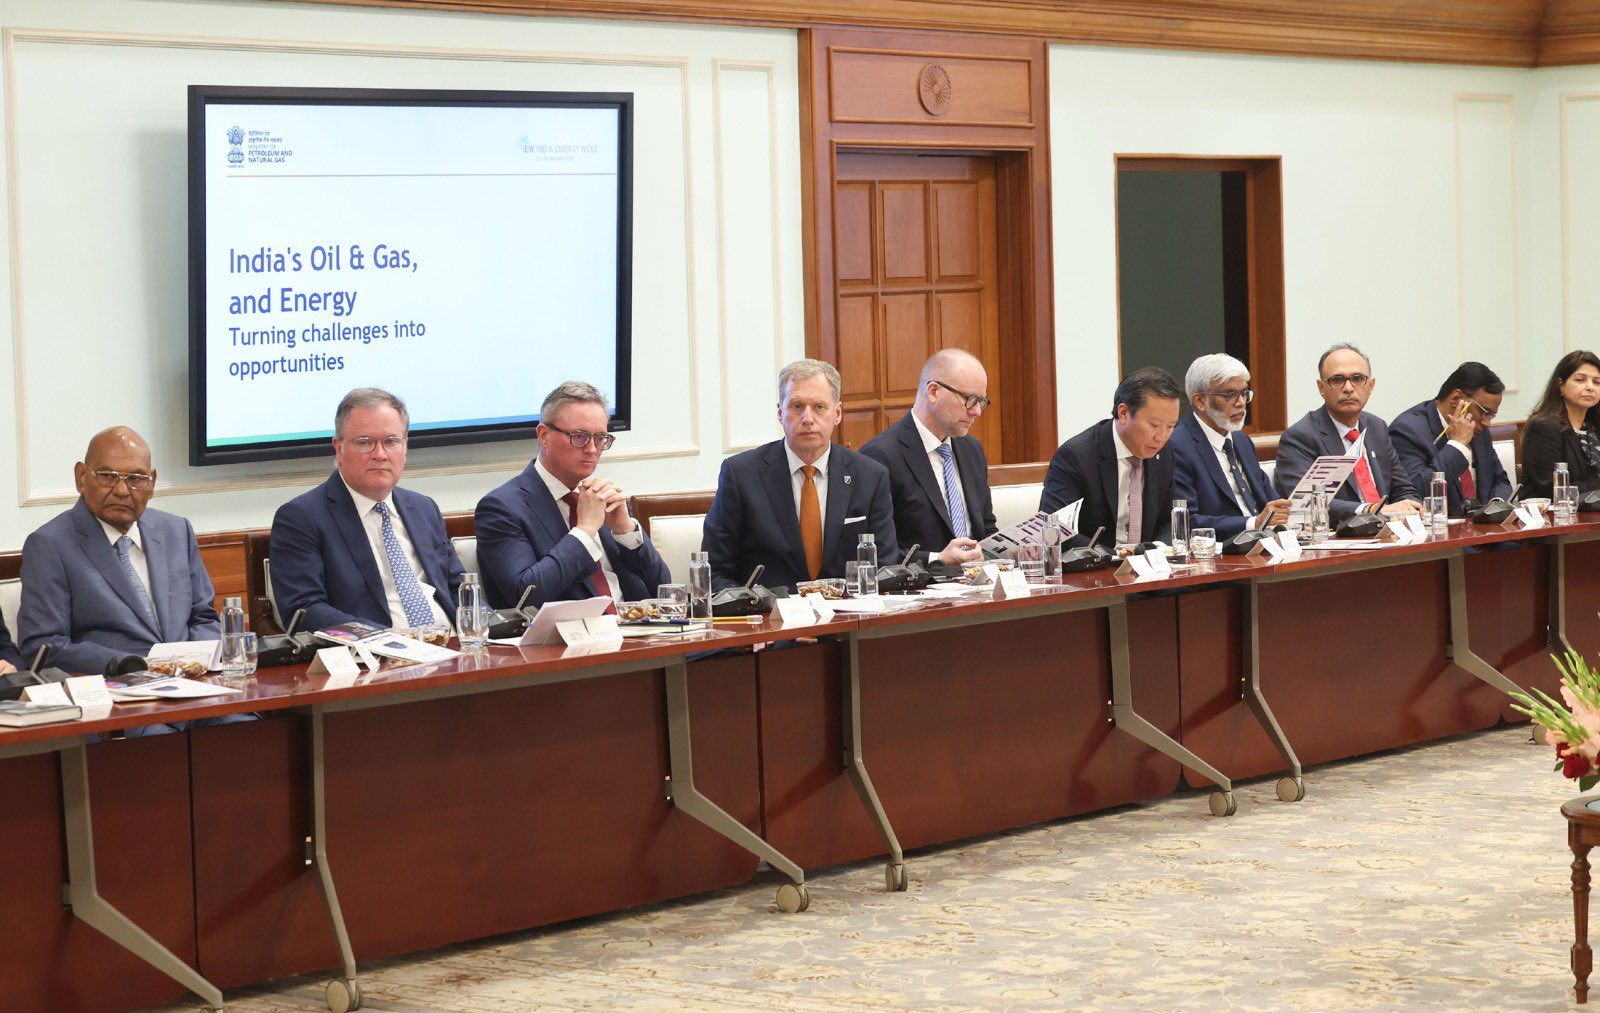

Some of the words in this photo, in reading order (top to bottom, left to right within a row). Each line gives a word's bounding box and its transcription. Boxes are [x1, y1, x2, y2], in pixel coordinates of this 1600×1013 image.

[229, 246, 303, 274] India's
[310, 244, 341, 272] Oil
[349, 244, 365, 271] &
[373, 243, 418, 273] Gas,
[228, 287, 272, 314] and
[279, 287, 358, 317] Energy
[228, 326, 297, 348] Turning
[301, 322, 389, 345] challenges
[393, 320, 426, 338] into
[228, 352, 345, 381] opportunities
